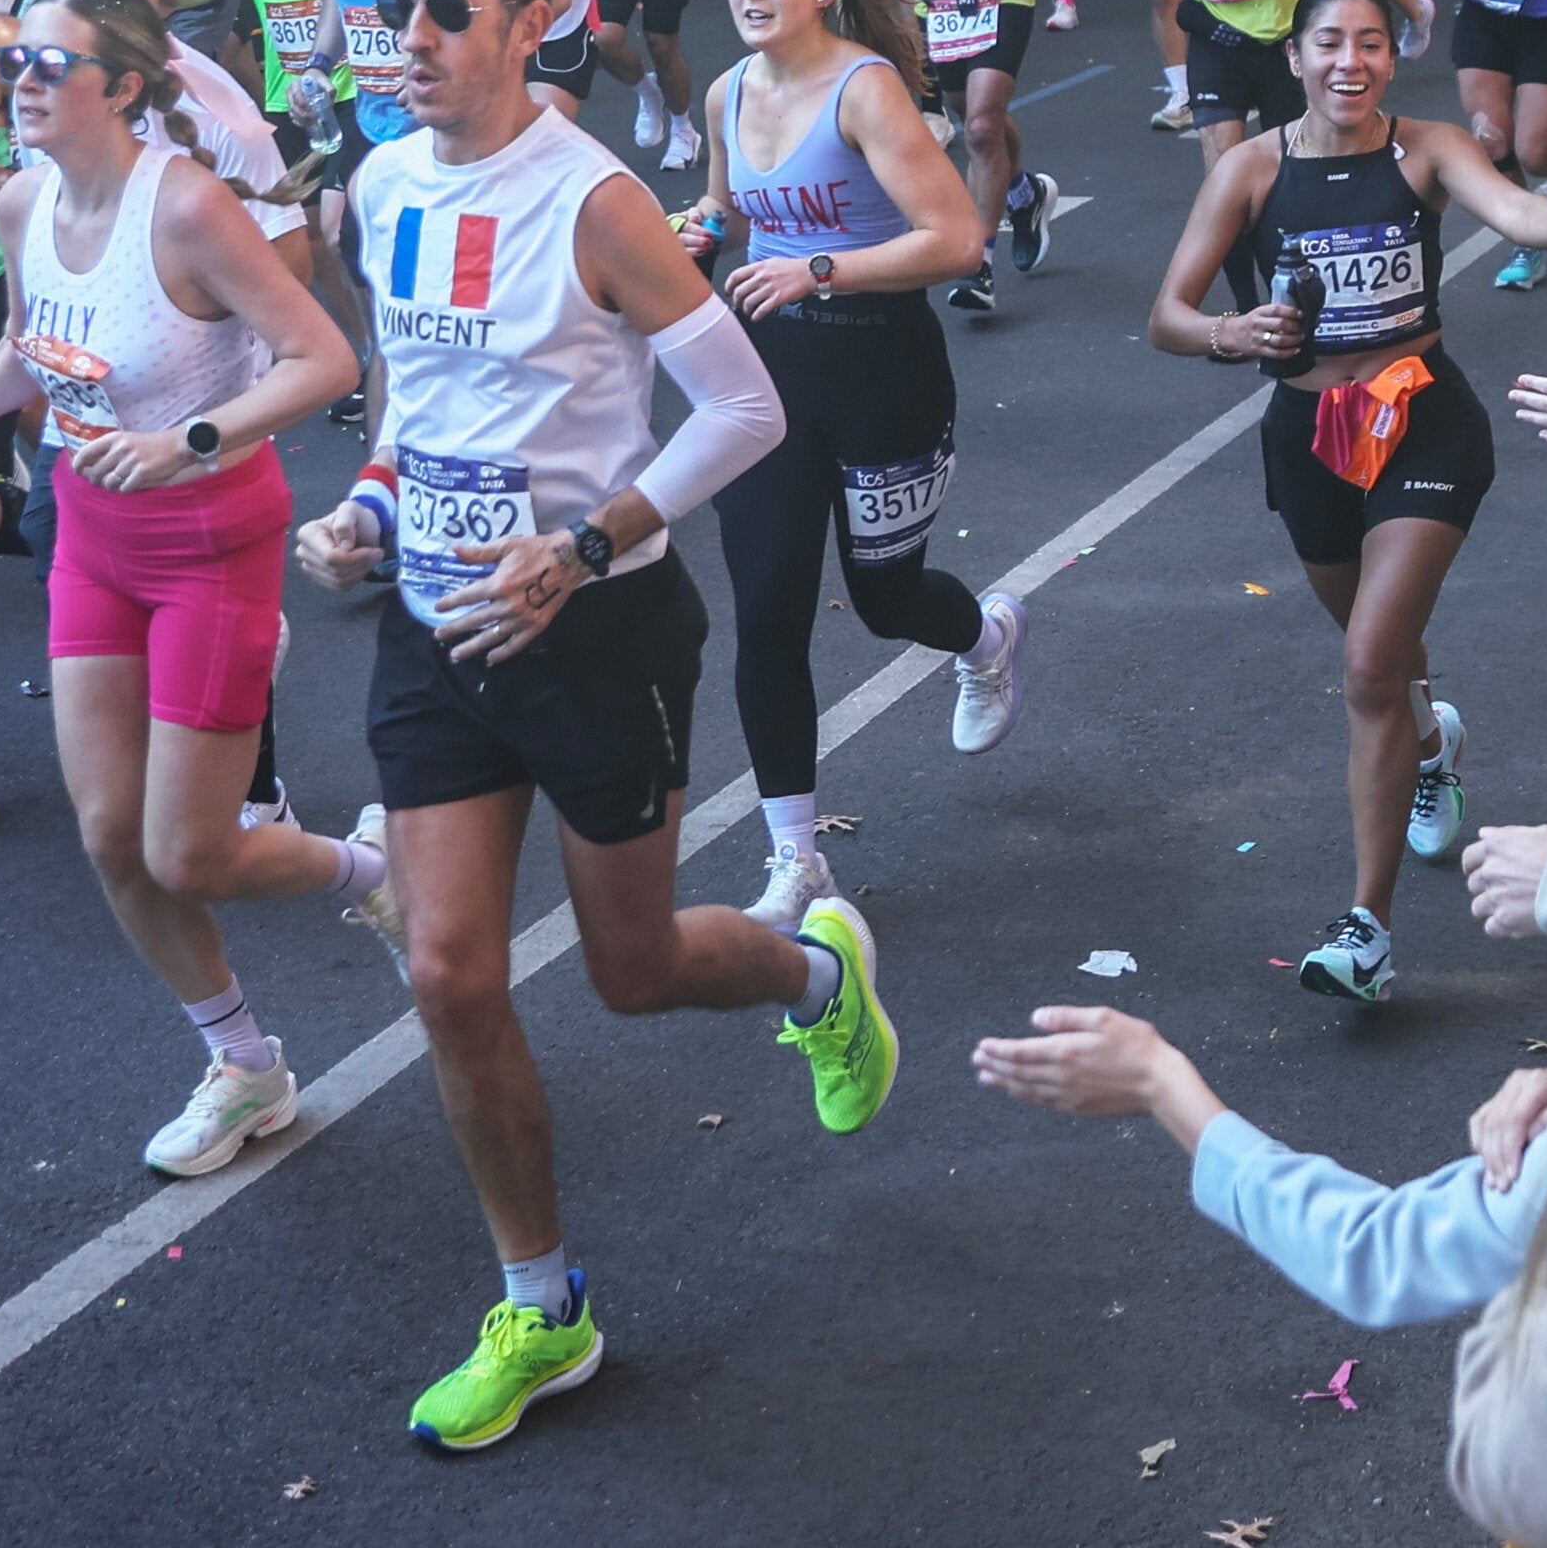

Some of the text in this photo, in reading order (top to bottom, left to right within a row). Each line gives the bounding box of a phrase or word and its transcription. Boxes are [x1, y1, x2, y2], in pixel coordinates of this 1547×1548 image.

[1327, 173, 1350, 181] BANDIT
[1300, 237, 1330, 255] tcs
[1384, 237, 1406, 247] TATA
[380, 304, 497, 349] VINCENT
[1395, 311, 1417, 325] 2025
[478, 479, 507, 490] TATA
[856, 470, 885, 487] tcs
[1413, 480, 1456, 493] BANDIT
[858, 463, 949, 525] 35177
[409, 484, 519, 543] 37362
